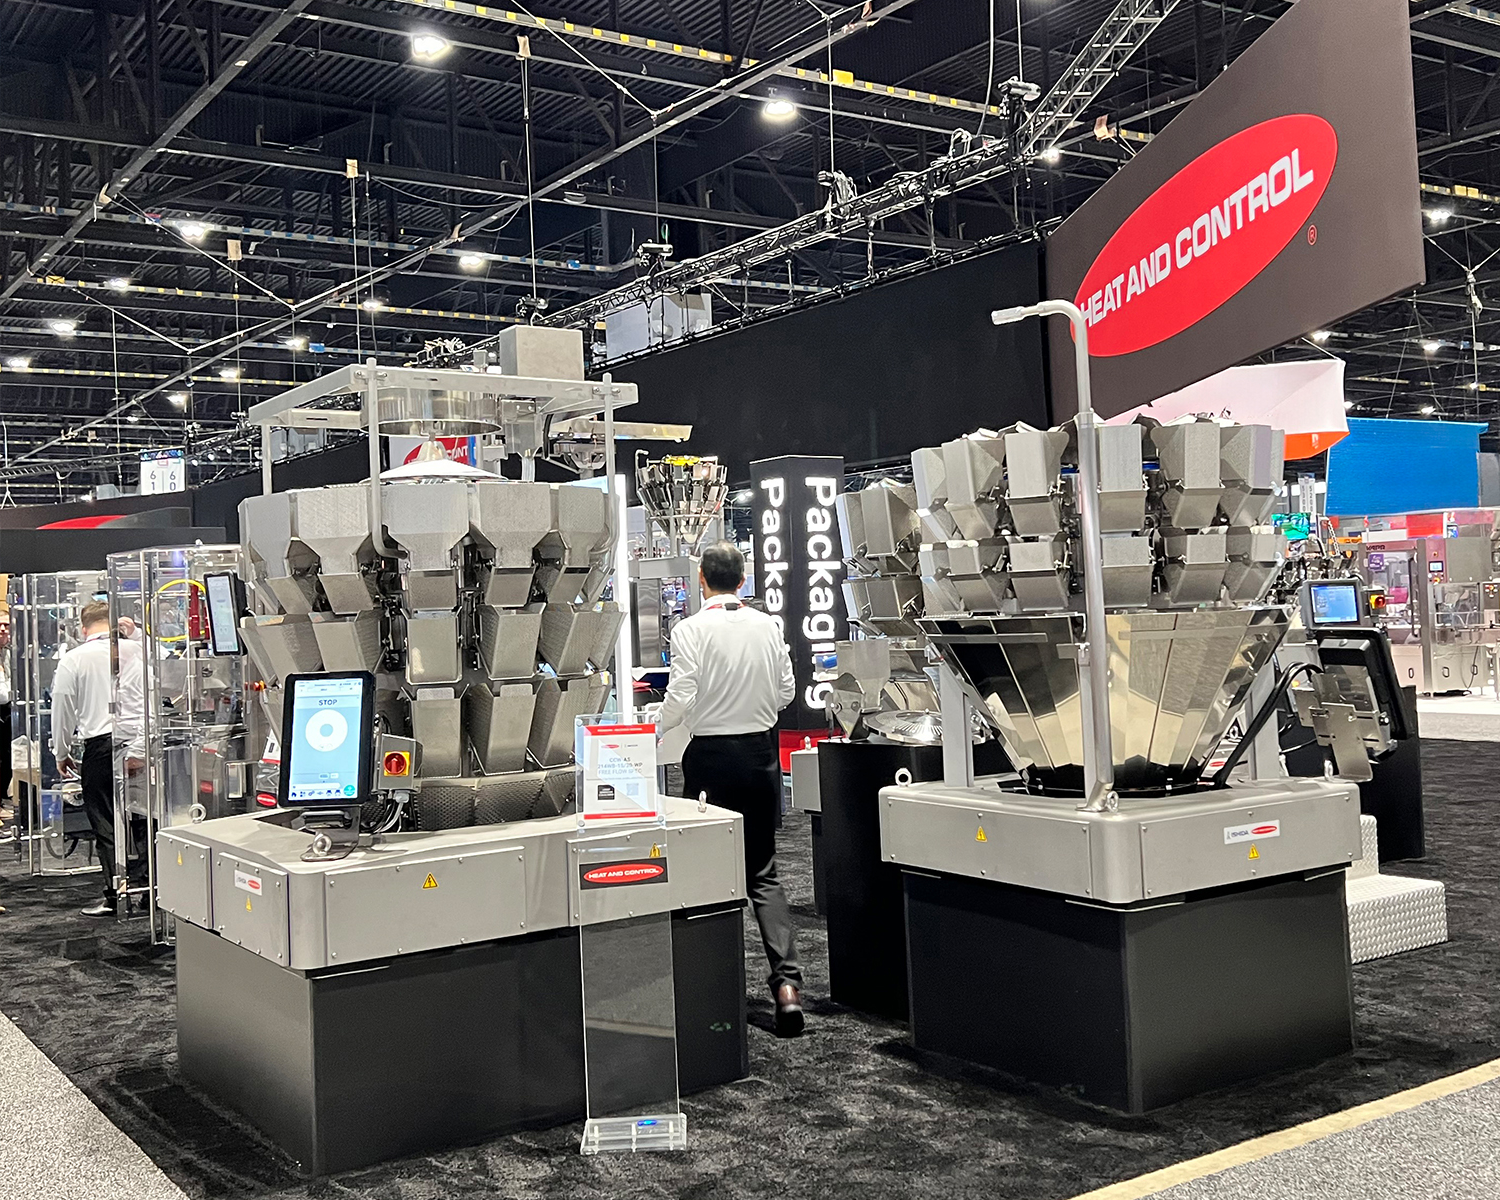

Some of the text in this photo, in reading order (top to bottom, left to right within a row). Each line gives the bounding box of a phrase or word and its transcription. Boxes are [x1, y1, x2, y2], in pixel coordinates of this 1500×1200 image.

[1079, 148, 1314, 328] HEAT AND CONTROL
[761, 477, 790, 653] Packa
[624, 868, 659, 876] CONTROL
